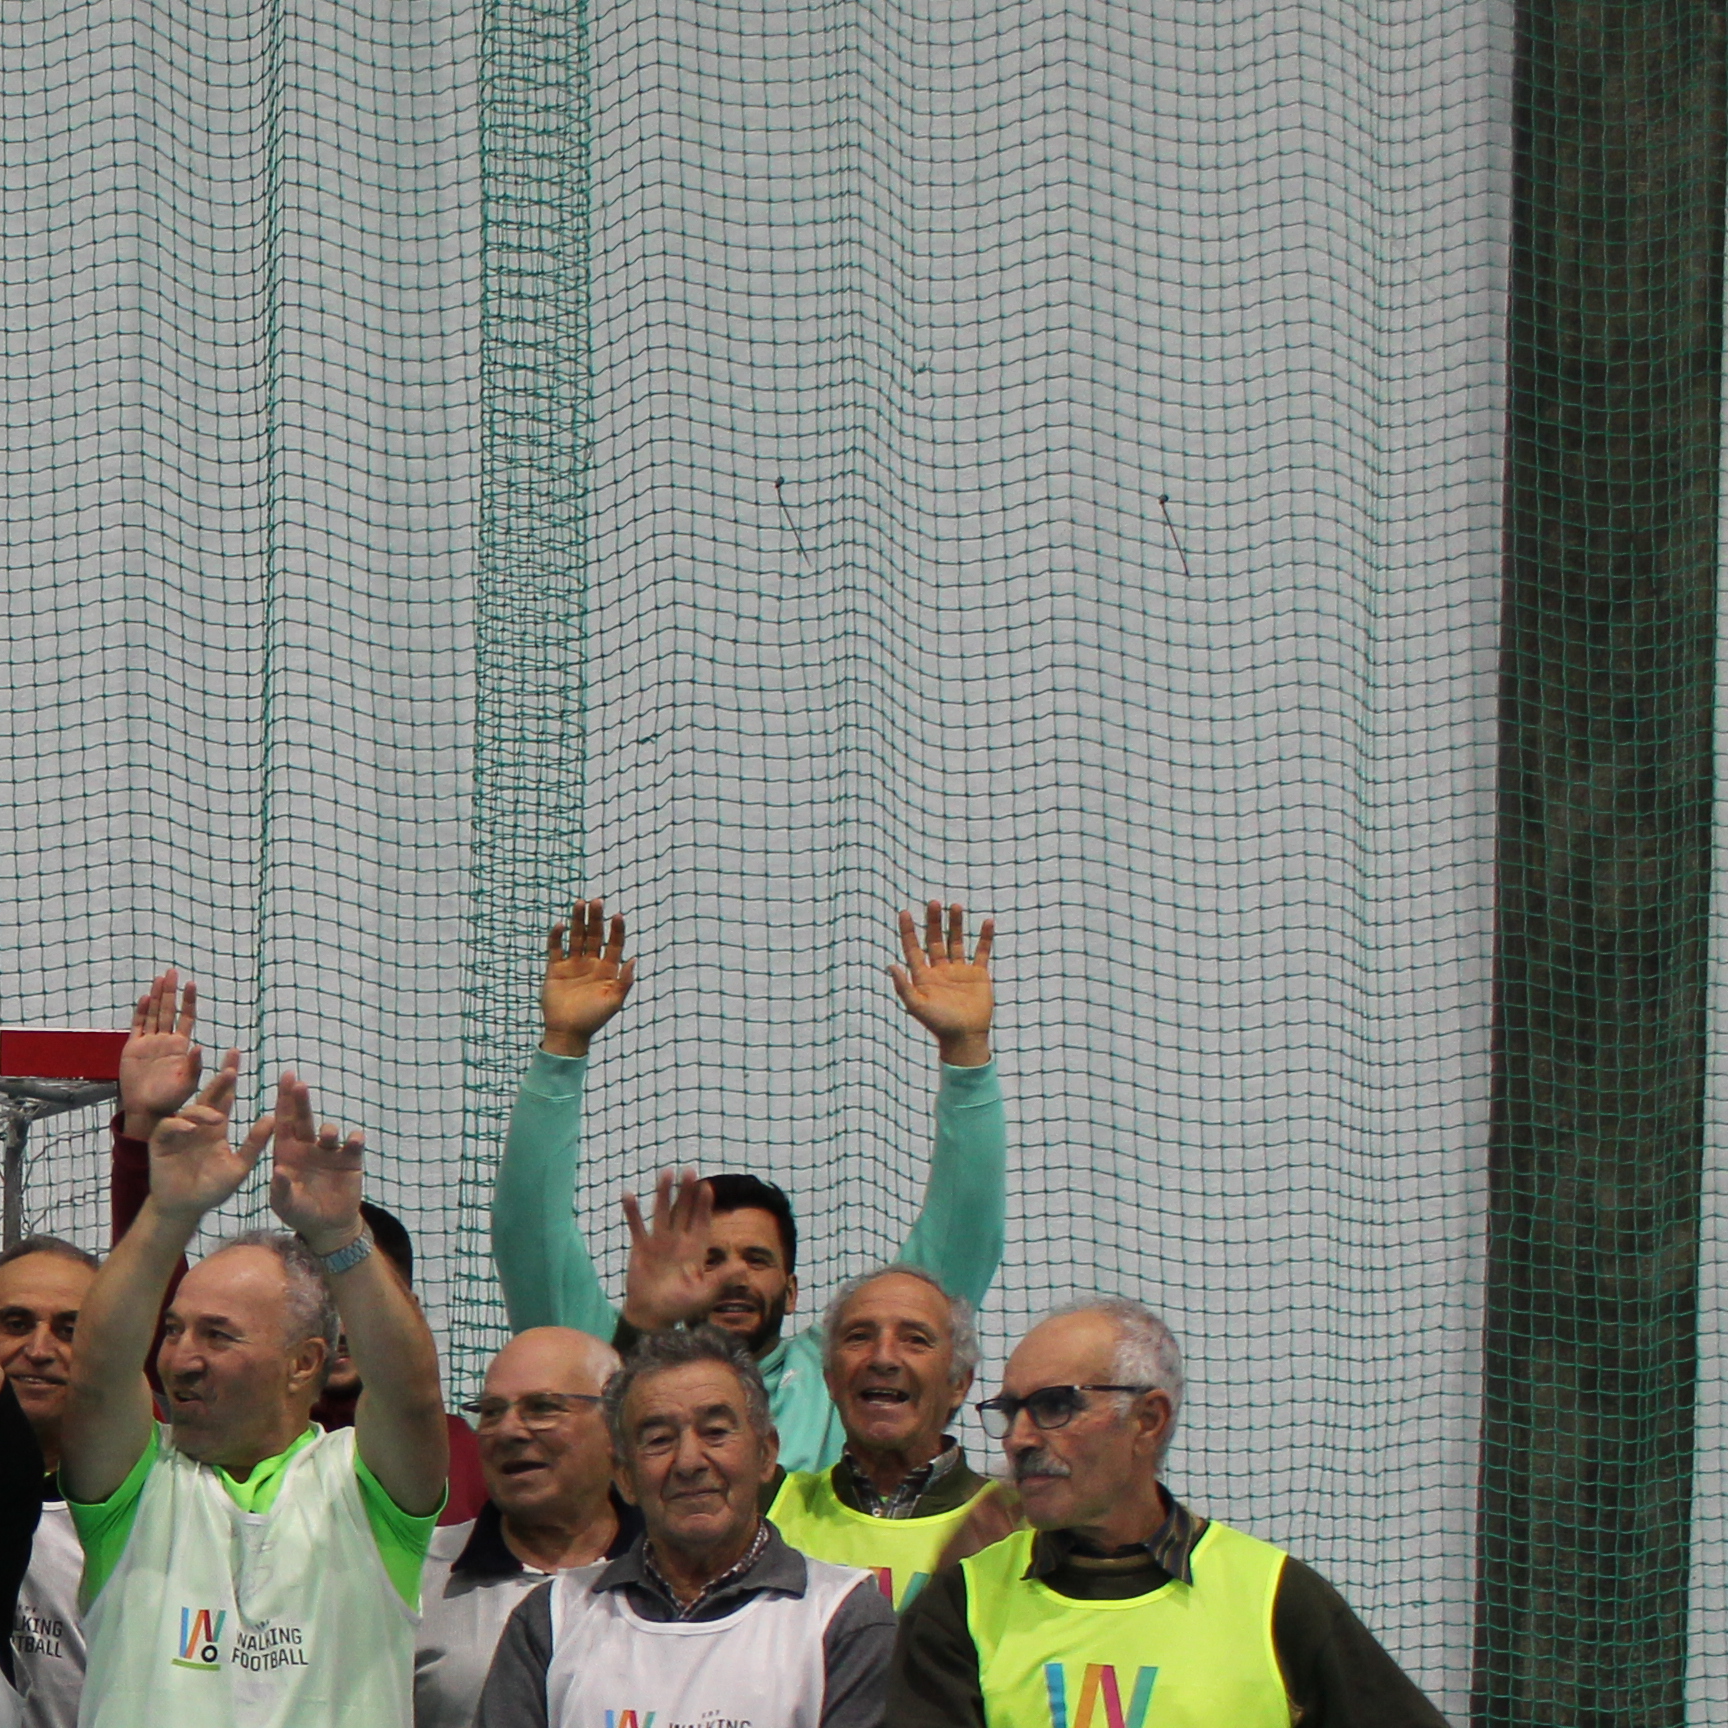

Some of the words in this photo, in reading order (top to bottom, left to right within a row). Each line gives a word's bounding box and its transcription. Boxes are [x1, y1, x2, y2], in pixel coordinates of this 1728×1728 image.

[13, 1615, 63, 1638] LKING
[12, 1635, 62, 1659] TBALL
[231, 1646, 309, 1672] FOOTBALL
